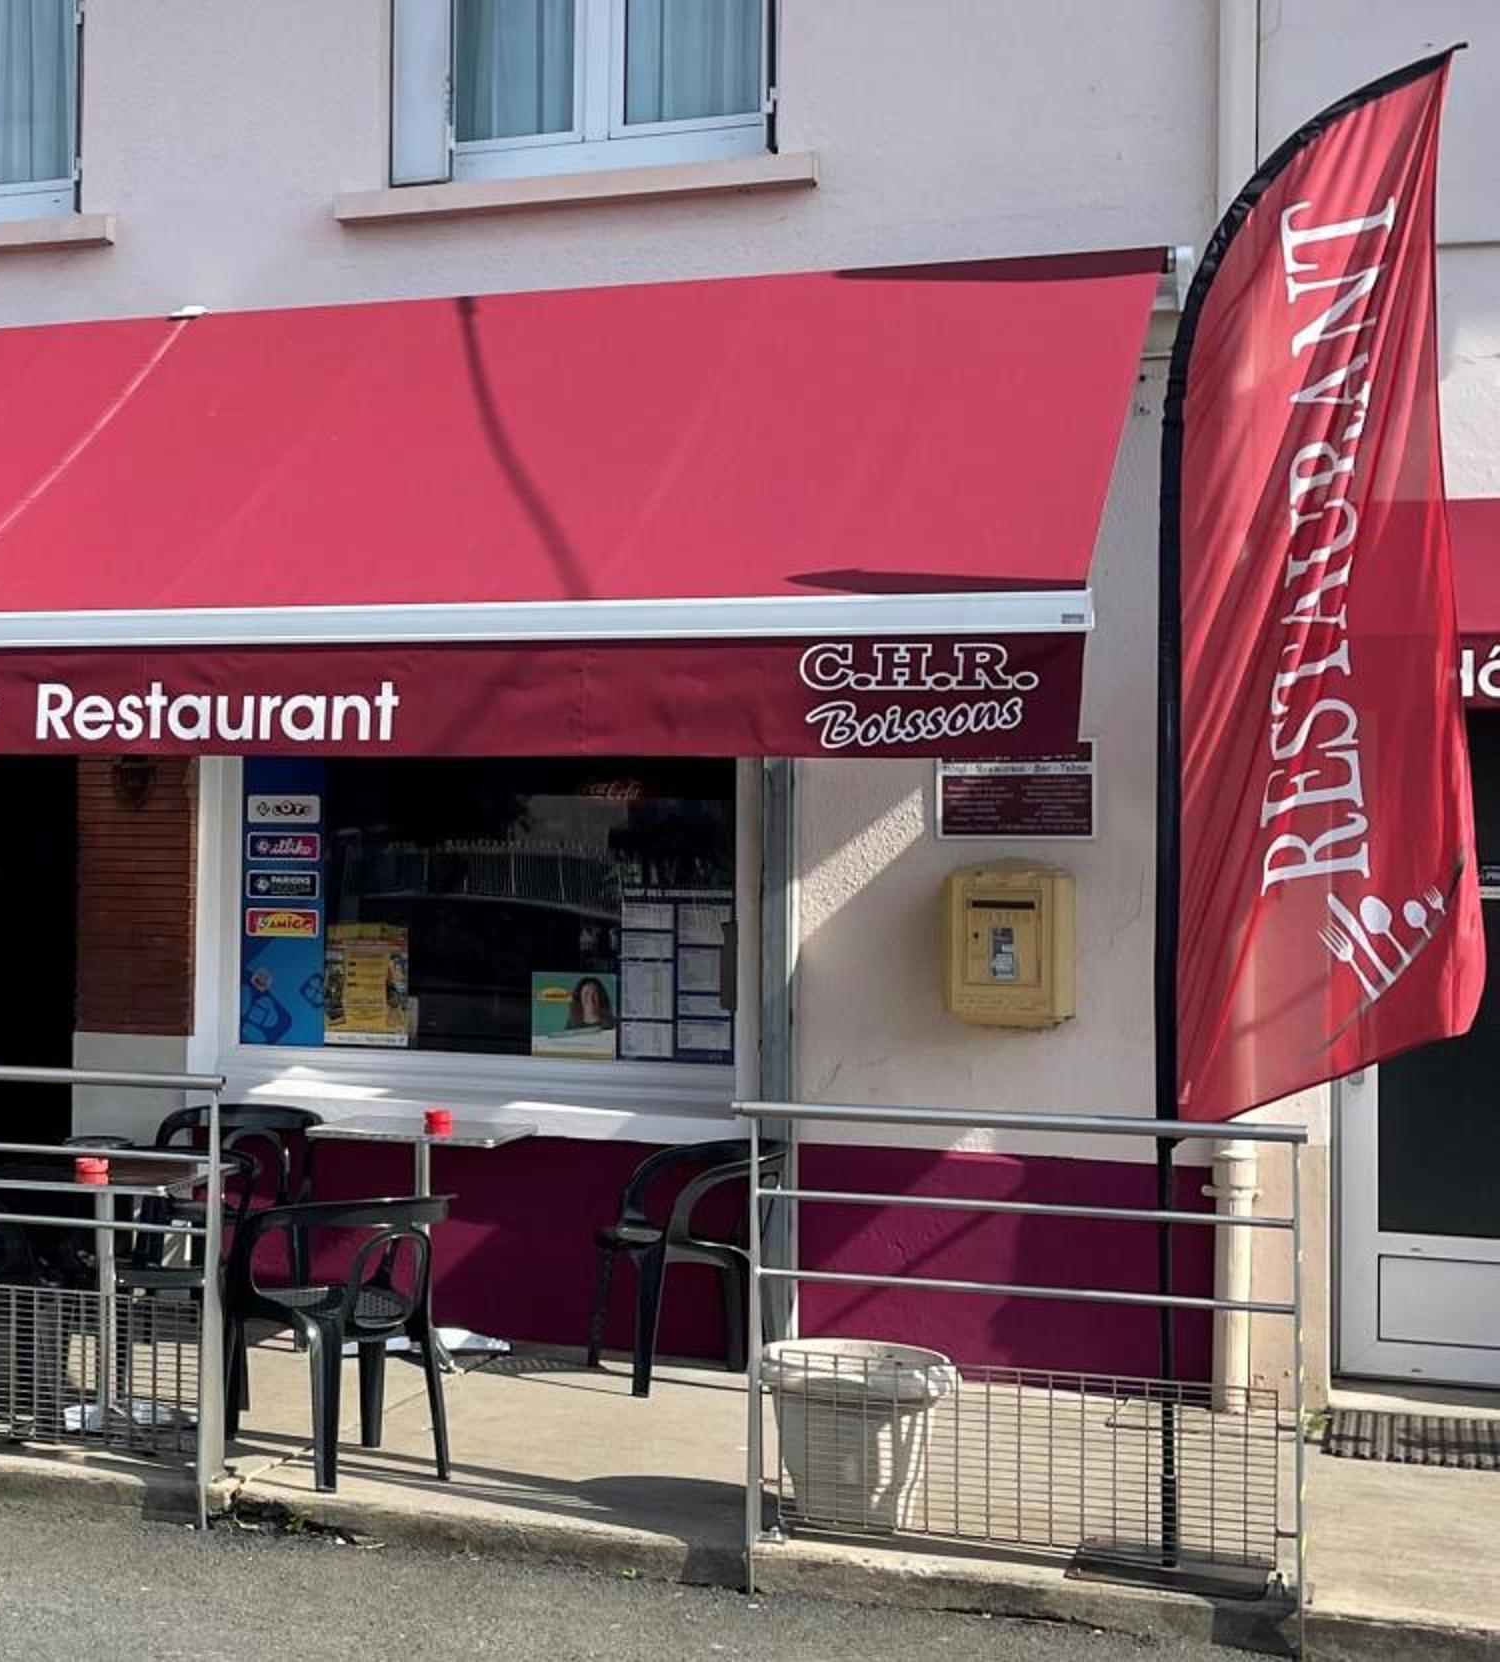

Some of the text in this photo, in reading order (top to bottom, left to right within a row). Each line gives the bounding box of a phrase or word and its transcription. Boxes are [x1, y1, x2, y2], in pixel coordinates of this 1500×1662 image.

[1260, 195, 1397, 897] RESTAURANT
[800, 643, 1040, 691] C.H.R.
[36, 681, 399, 741] Restaurant
[806, 697, 1023, 748] Boissons
